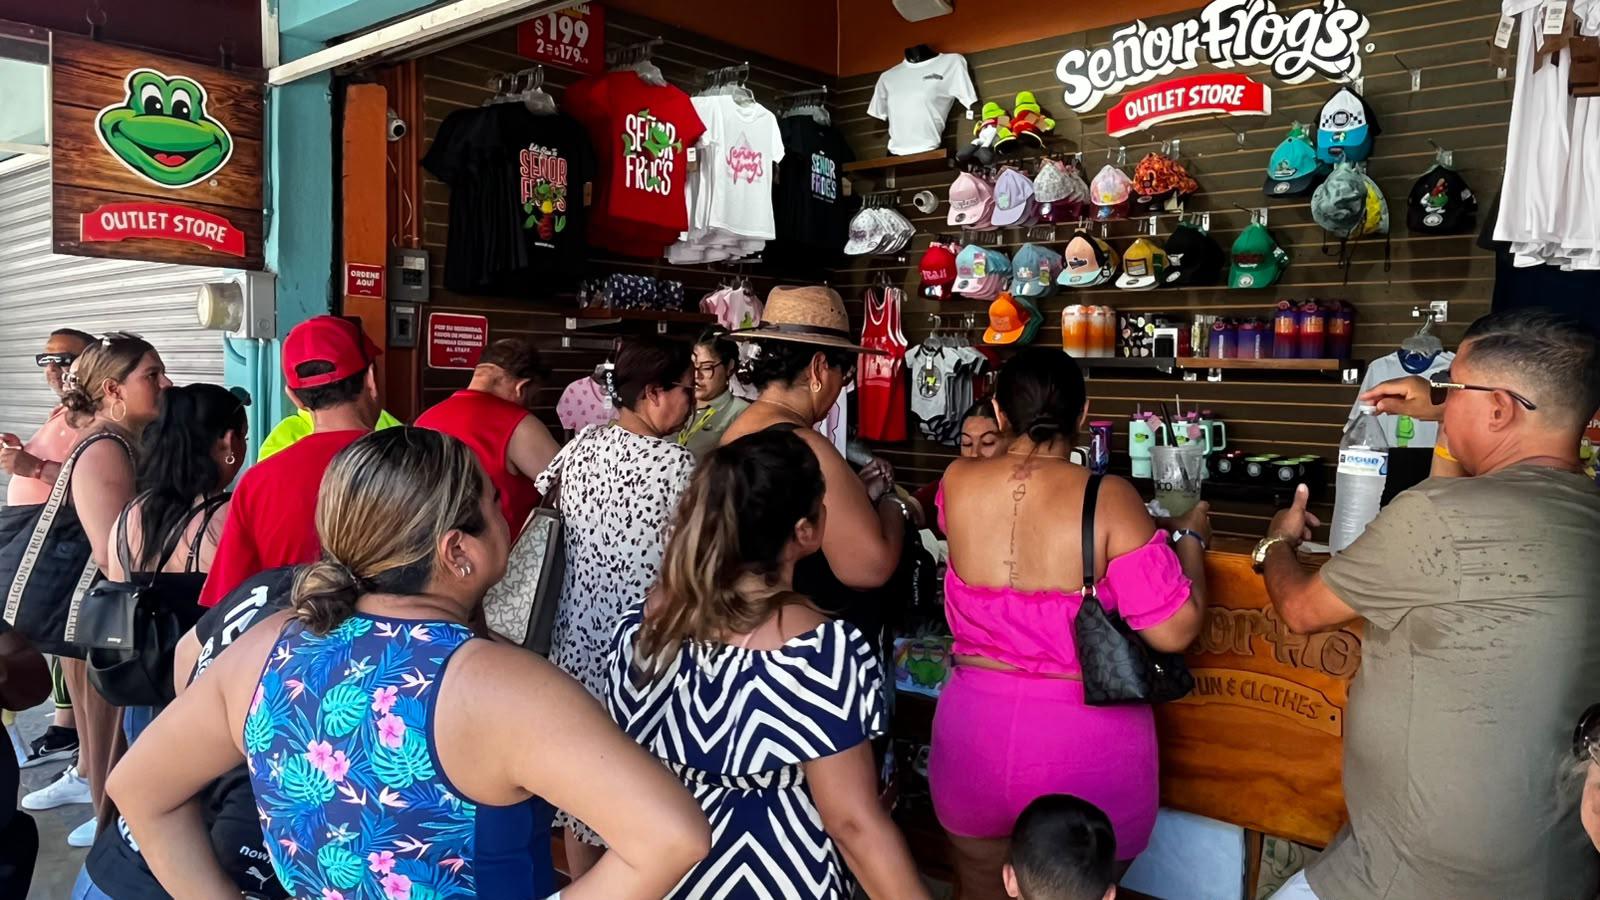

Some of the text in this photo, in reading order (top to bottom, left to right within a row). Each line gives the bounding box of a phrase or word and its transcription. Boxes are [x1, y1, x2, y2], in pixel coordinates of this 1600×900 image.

[1055, 19, 1200, 112] Señor
[1124, 84, 1246, 121] OUTLET STORE
[100, 210, 227, 243] OUTLET STORE
[350, 269, 380, 280] ORDENE
[5, 469, 70, 620] RELIGION TRUE RELIGION
[1240, 680, 1323, 719] CLOTHES
